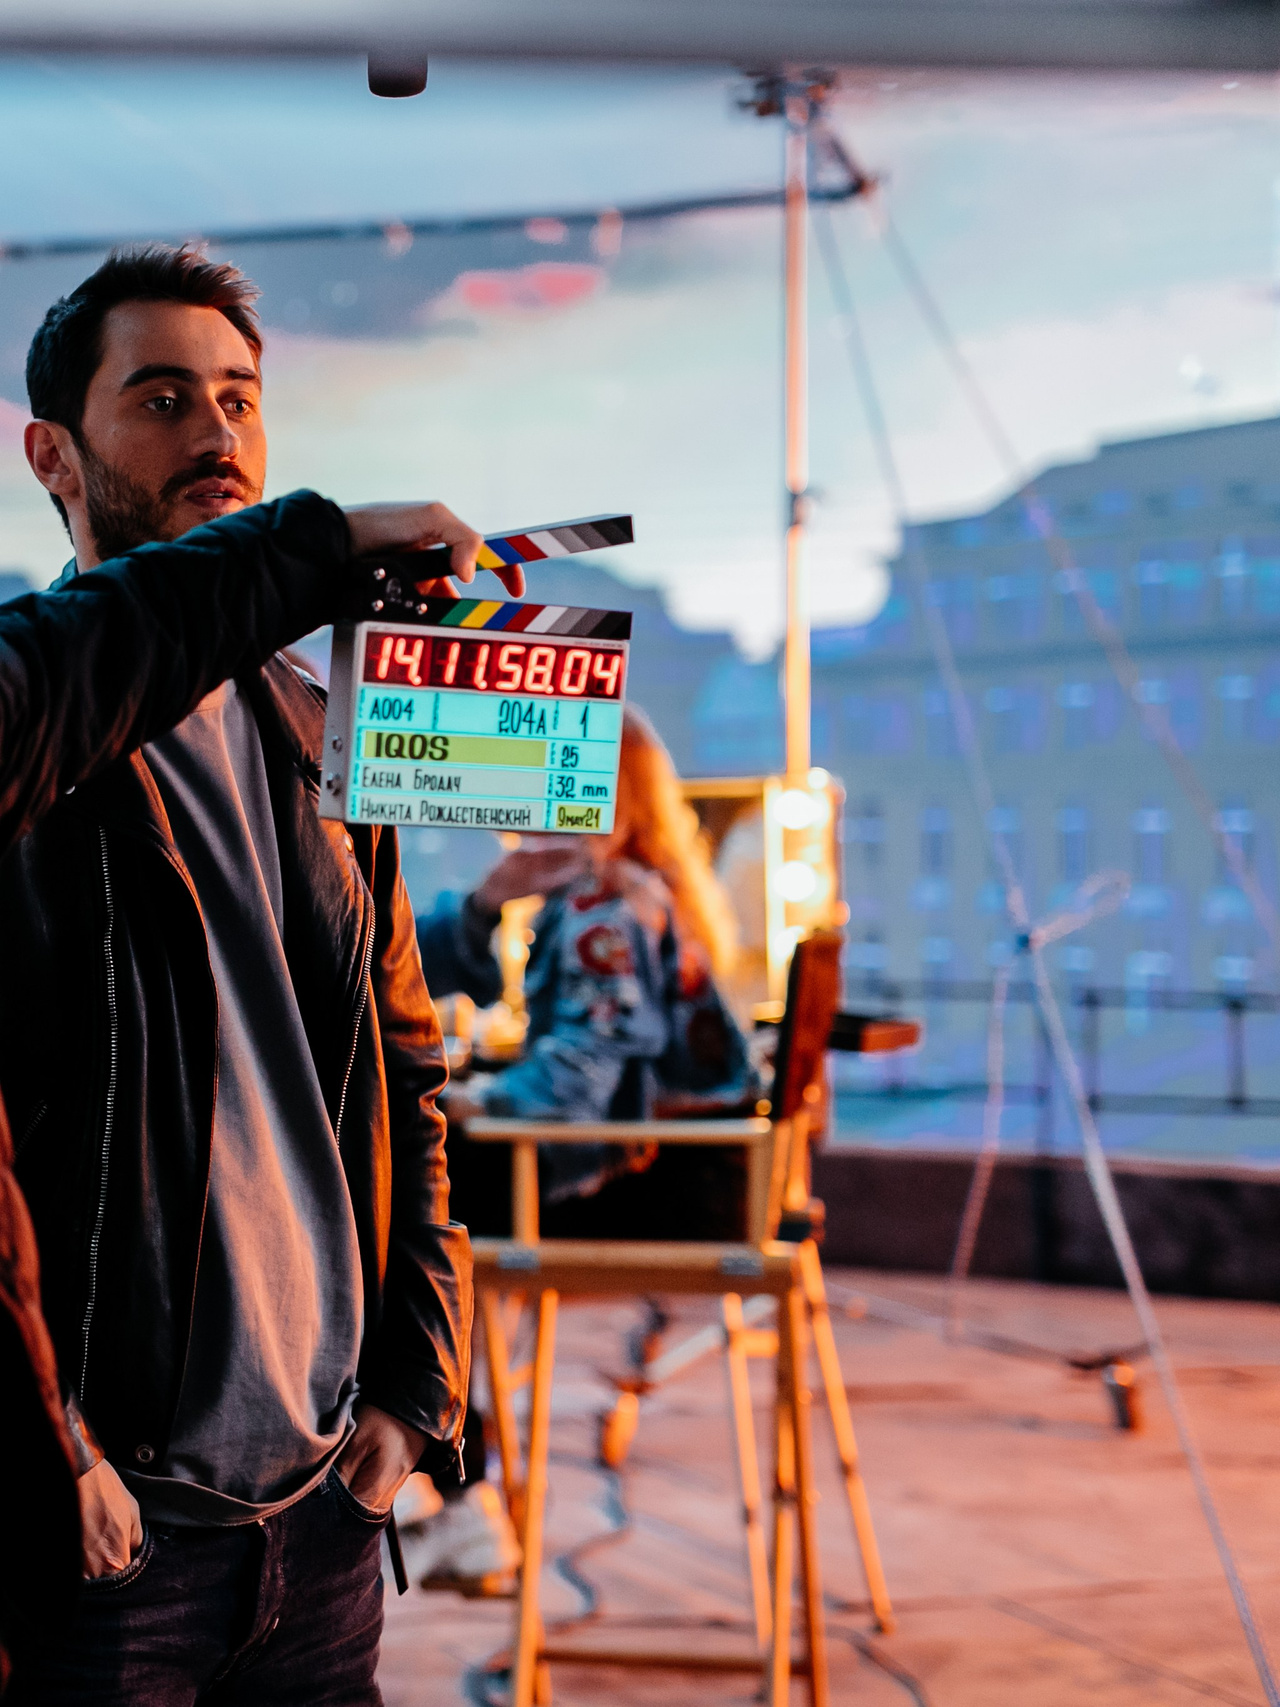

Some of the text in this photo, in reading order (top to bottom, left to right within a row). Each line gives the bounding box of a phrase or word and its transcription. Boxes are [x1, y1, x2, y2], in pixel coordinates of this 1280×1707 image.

[369, 698, 413, 721] A004
[498, 700, 546, 735] 204A
[580, 704, 589, 738] 1
[375, 732, 449, 761] IQOS
[561, 745, 579, 768] 25
[555, 775, 575, 798] 32
[582, 786, 608, 797] mm
